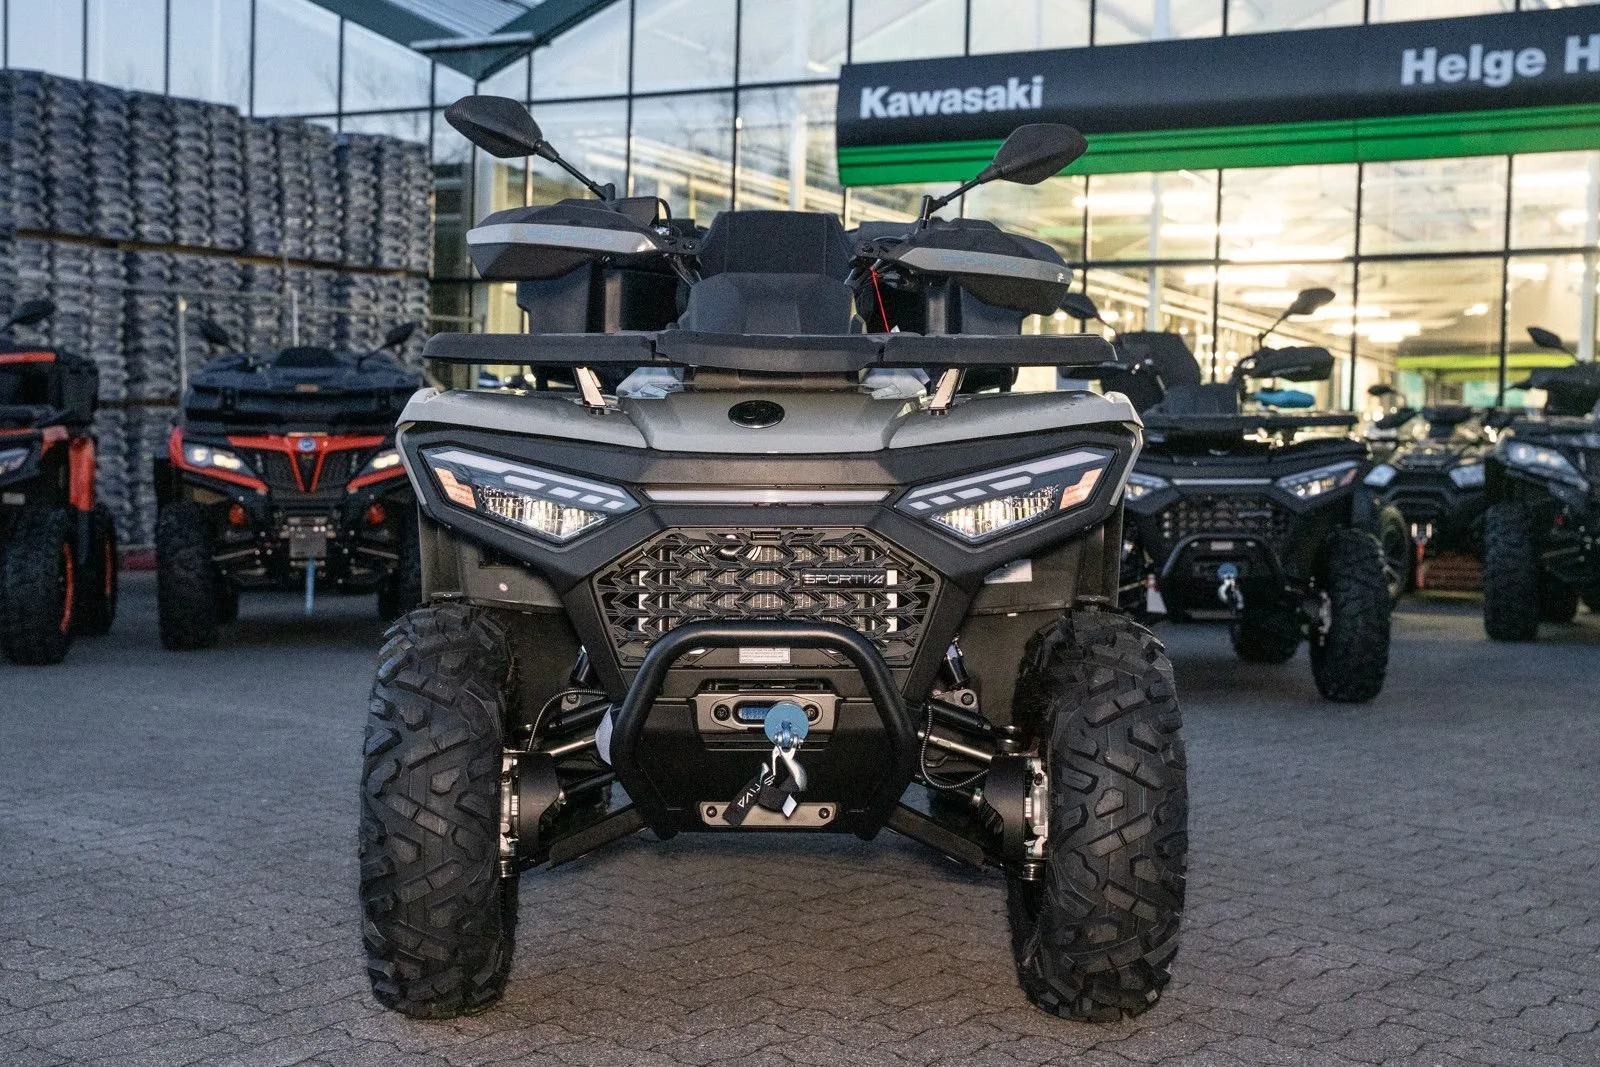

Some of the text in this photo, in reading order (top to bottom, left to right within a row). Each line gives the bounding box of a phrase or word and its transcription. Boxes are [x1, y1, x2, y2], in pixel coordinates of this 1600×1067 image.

[1401, 43, 1547, 87] Helge
[860, 75, 1044, 119] Kawasaki
[802, 574, 884, 584] SPORTIVA
